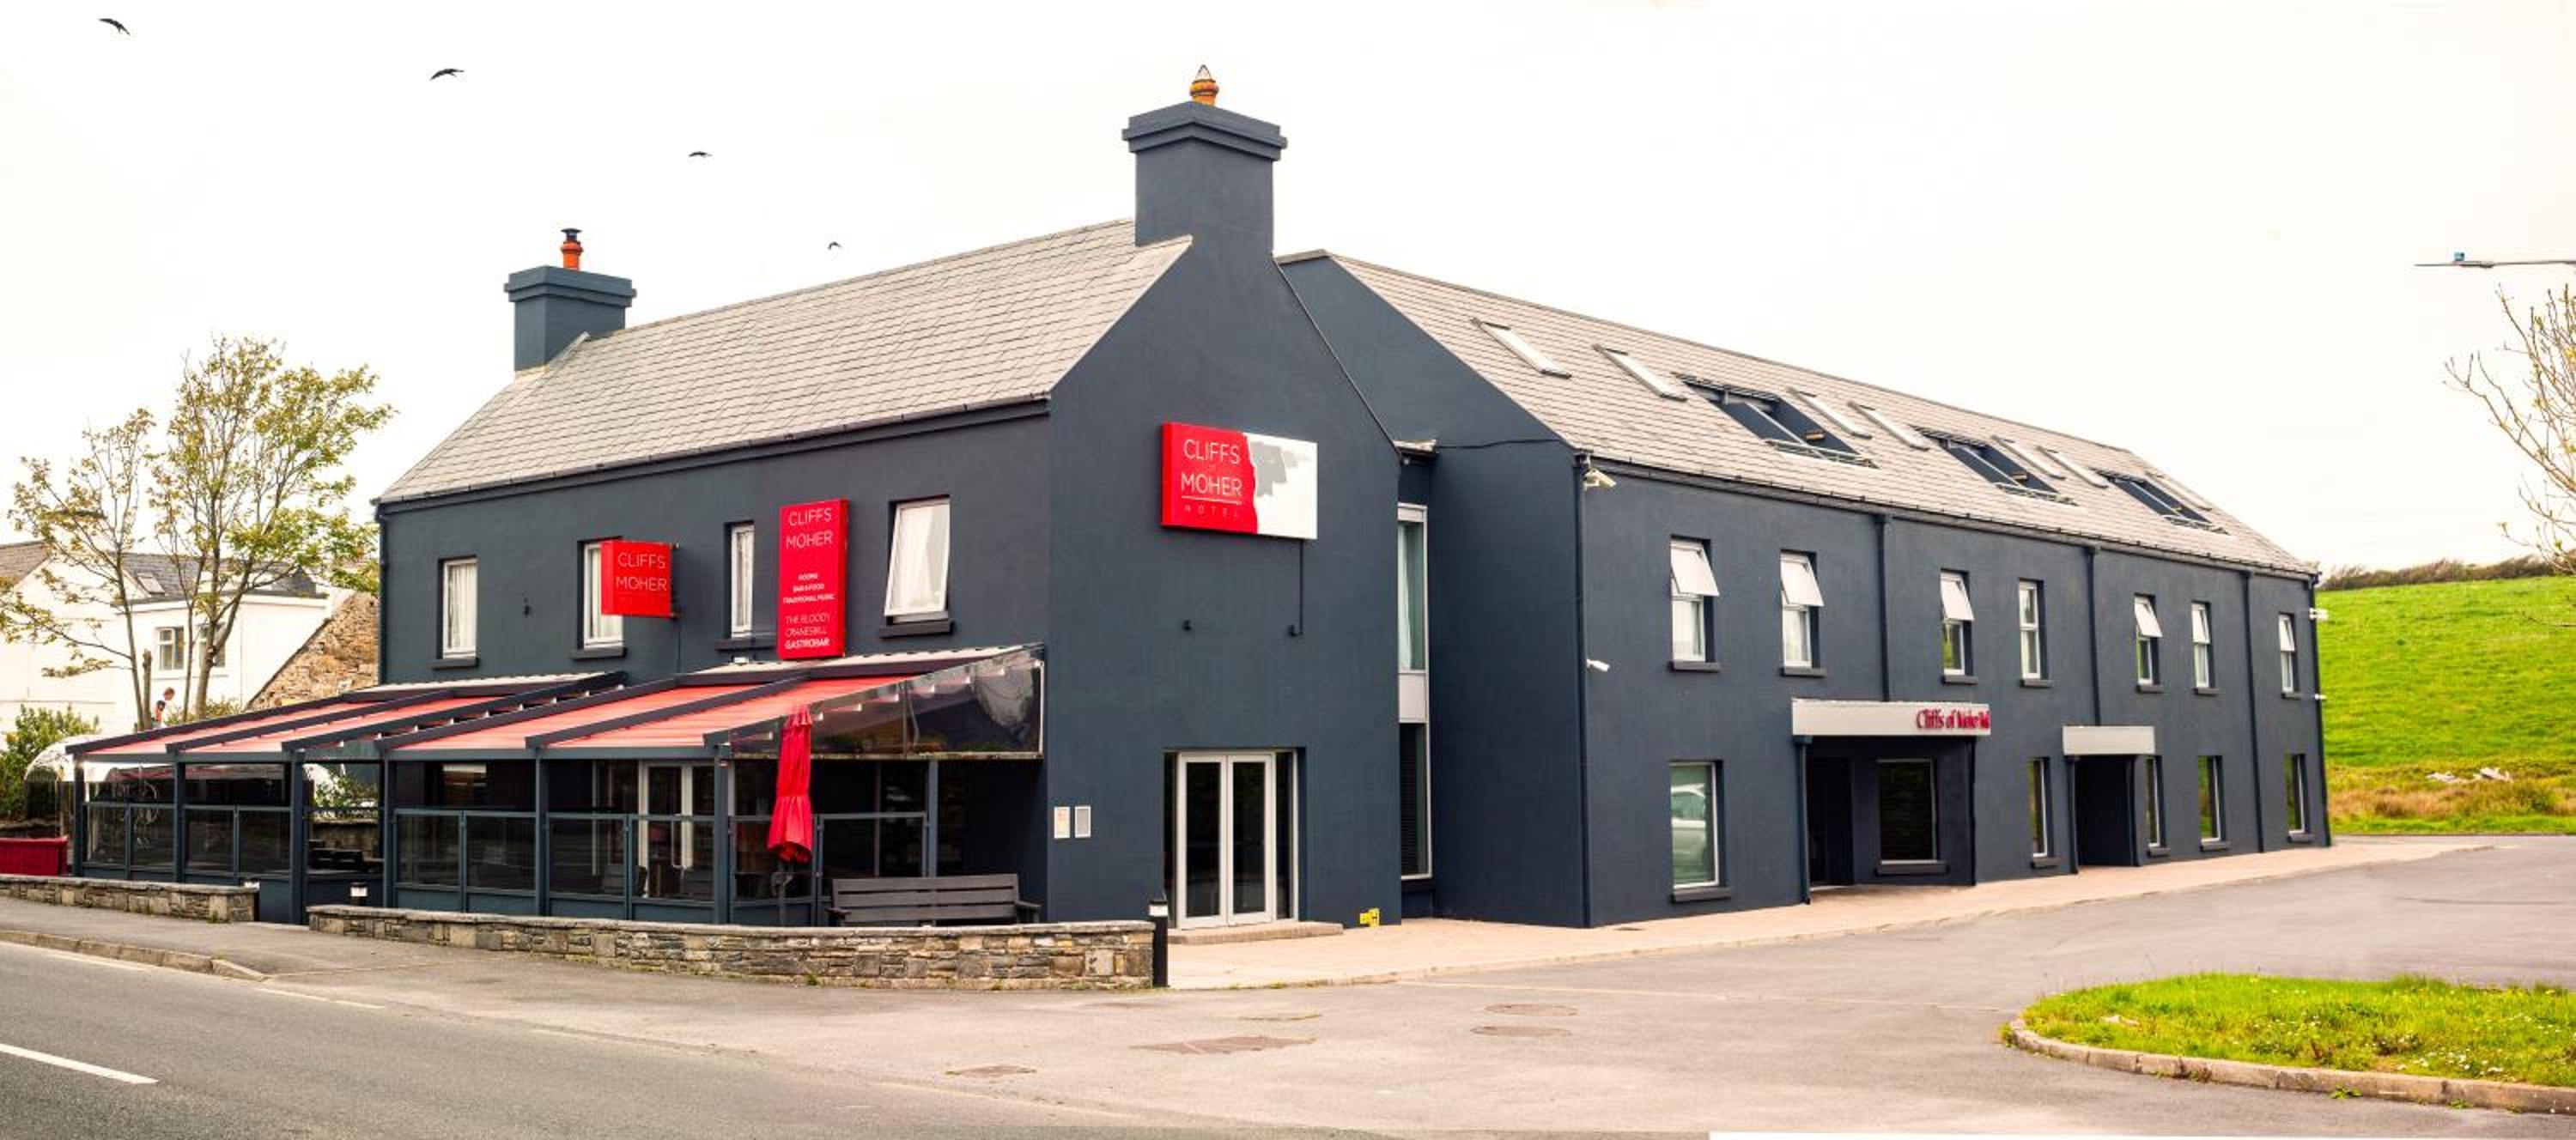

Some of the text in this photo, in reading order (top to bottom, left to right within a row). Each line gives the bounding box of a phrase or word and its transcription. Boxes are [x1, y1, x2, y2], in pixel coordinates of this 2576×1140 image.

[1183, 439, 1241, 464] CLIFFS
[1181, 472, 1242, 496] MOHER
[789, 507, 832, 526] CLIFFS
[1184, 505, 1237, 518] HOTEL
[786, 530, 833, 549] MOHER
[617, 552, 665, 569] CLIFFS
[616, 576, 667, 591] MOHER
[785, 612, 830, 624] THE BLOODY
[784, 637, 831, 651] GASTROBAR
[1917, 709, 1944, 728] Cliffs
